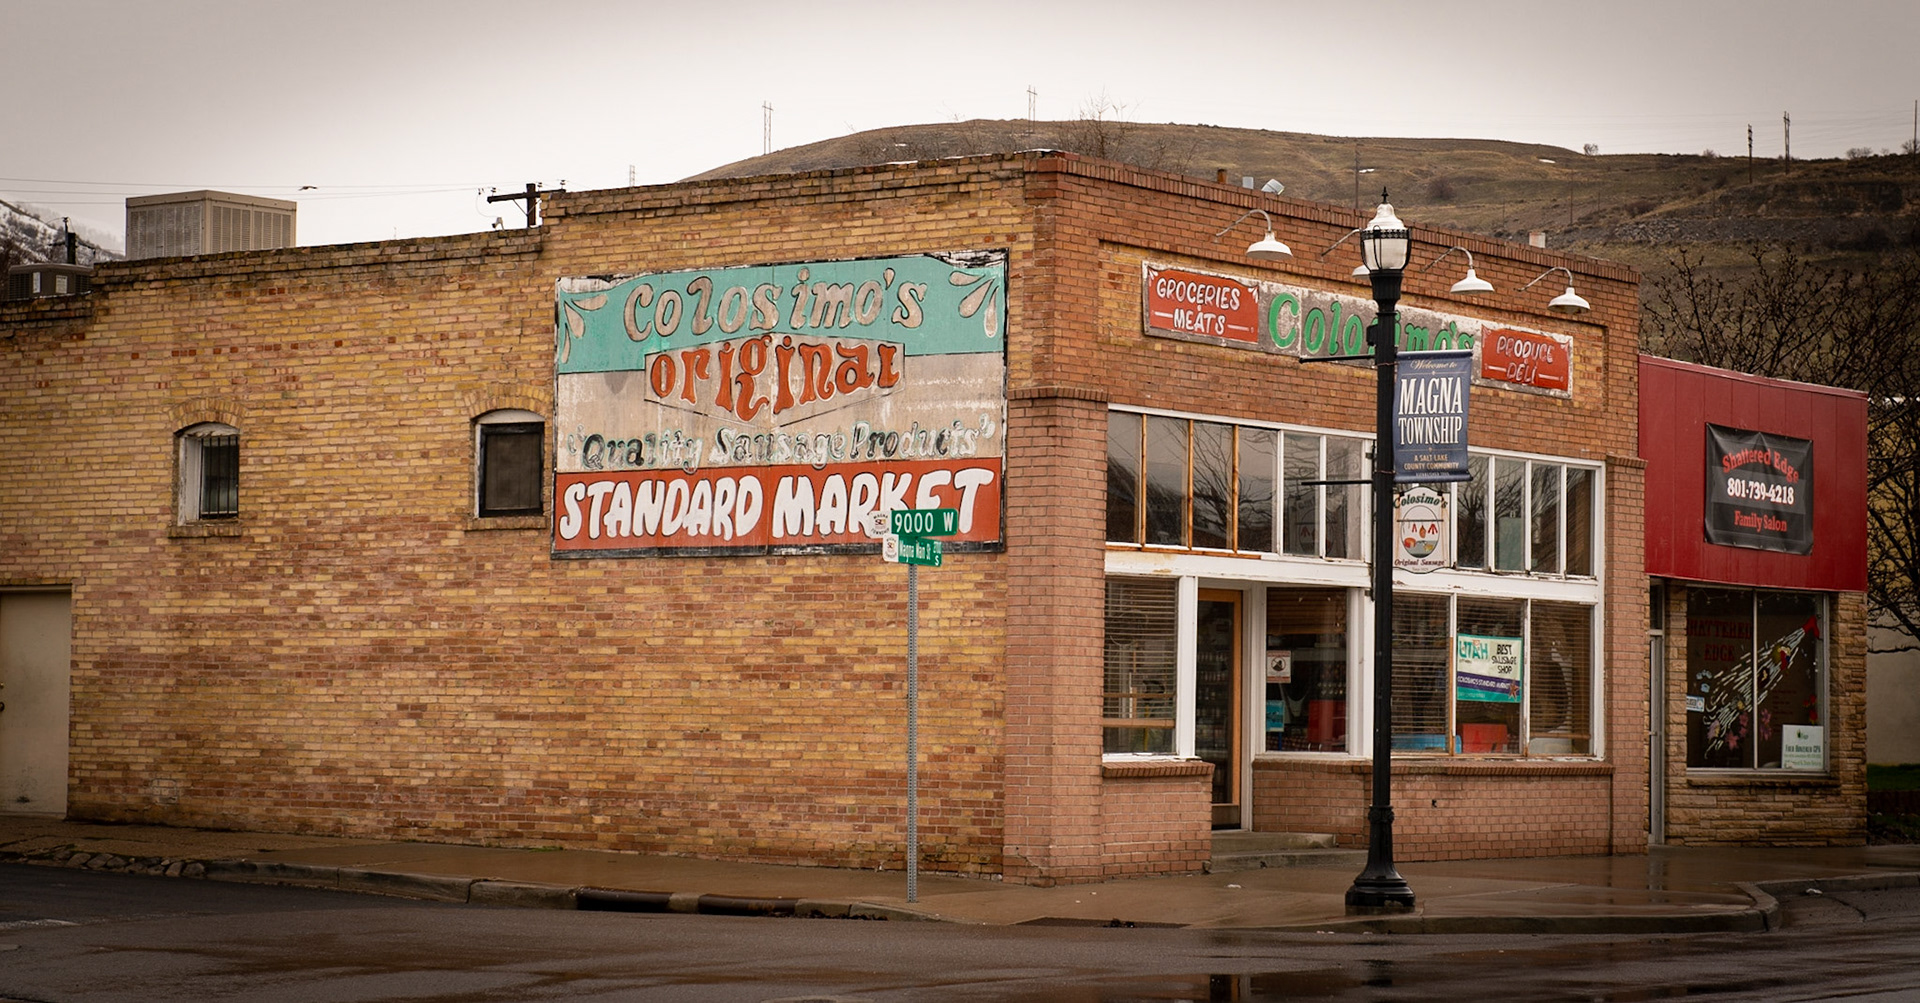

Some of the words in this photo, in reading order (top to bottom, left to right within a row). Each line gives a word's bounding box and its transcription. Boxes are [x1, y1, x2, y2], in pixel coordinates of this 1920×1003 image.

[623, 267, 927, 343] Colosimo's
[1156, 277, 1240, 311] GROCERIES
[1173, 308, 1226, 335] MEATS
[1496, 335, 1554, 364] PRODUCE
[1410, 359, 1448, 370] Welcome
[1507, 362, 1538, 384] DELI
[1398, 377, 1463, 415] MAGNA
[1398, 416, 1462, 445] TOWNSHIP
[708, 426, 846, 470] Sausage
[1433, 454, 1448, 462] LAKE
[1426, 462, 1459, 470] COMMUNITY
[1722, 448, 1771, 473] Shattered
[1773, 450, 1799, 483] Edge
[1393, 493, 1448, 509] Colosimo's
[1727, 477, 1794, 505] 801-739-4218
[559, 475, 763, 541] STANDARD
[772, 468, 995, 540] MARKET
[895, 512, 933, 533] 9000
[943, 512, 954, 532] W
[1734, 510, 1762, 532] Family
[1763, 515, 1787, 532] Salon
[934, 555, 940, 566] S
[1394, 559, 1419, 568] Original
[1458, 640, 1488, 660] UTAH
[1496, 644, 1512, 655] BEST
[1704, 644, 1735, 661] EDGE
[1497, 666, 1512, 674] SHOP
